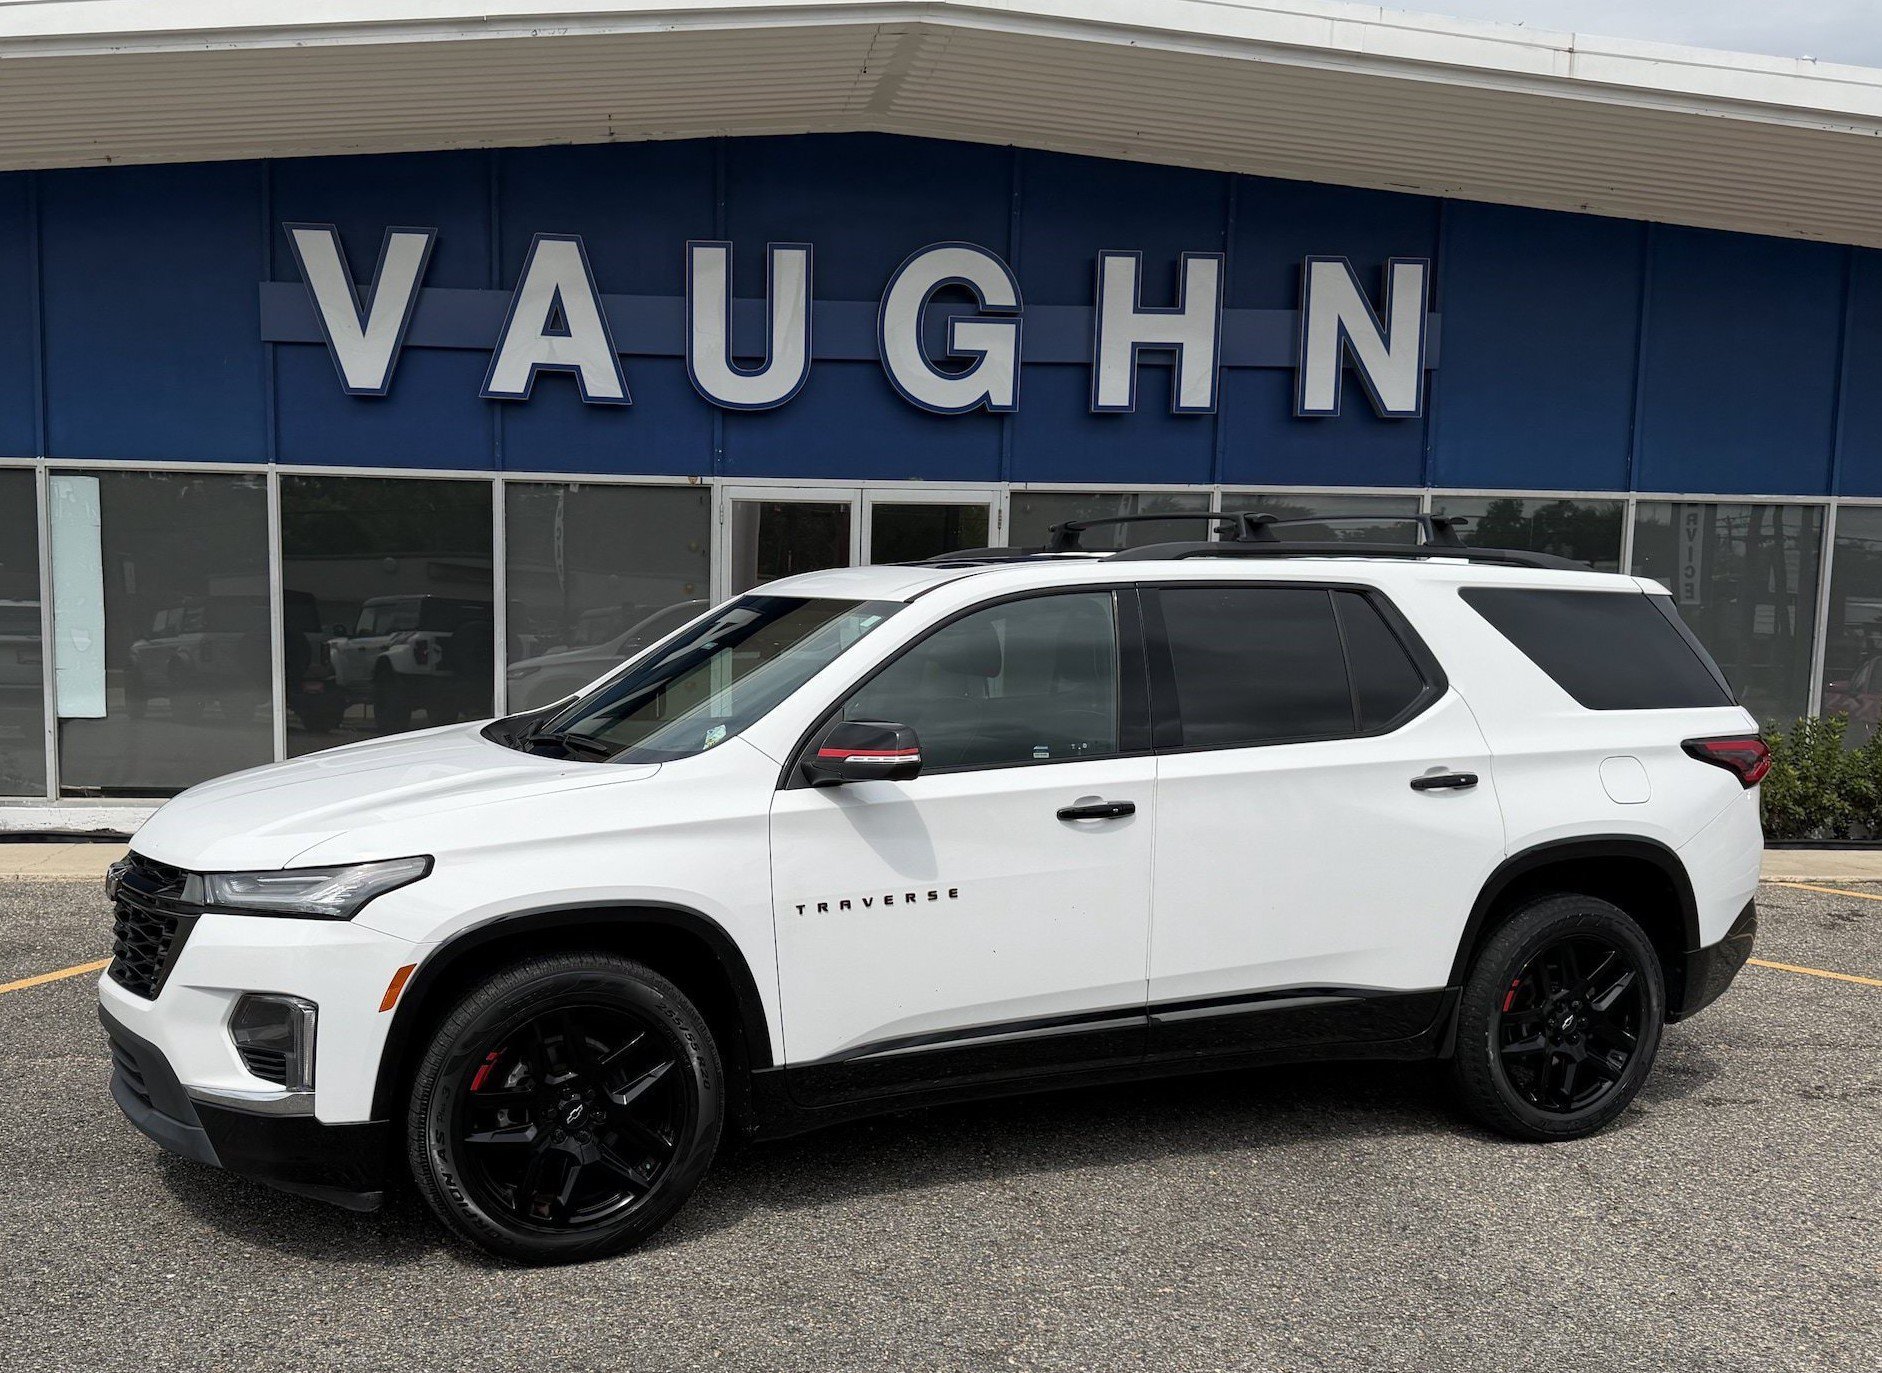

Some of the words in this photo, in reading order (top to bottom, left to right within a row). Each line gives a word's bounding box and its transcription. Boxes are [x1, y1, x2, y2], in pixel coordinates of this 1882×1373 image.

[284, 222, 1430, 418] VAUGHN
[796, 888, 959, 915] TRAVERSE
[655, 1003, 701, 1052] 255/55
[696, 1056, 711, 1090] R20
[441, 1085, 451, 1099] 3
[435, 1129, 448, 1164] AS
